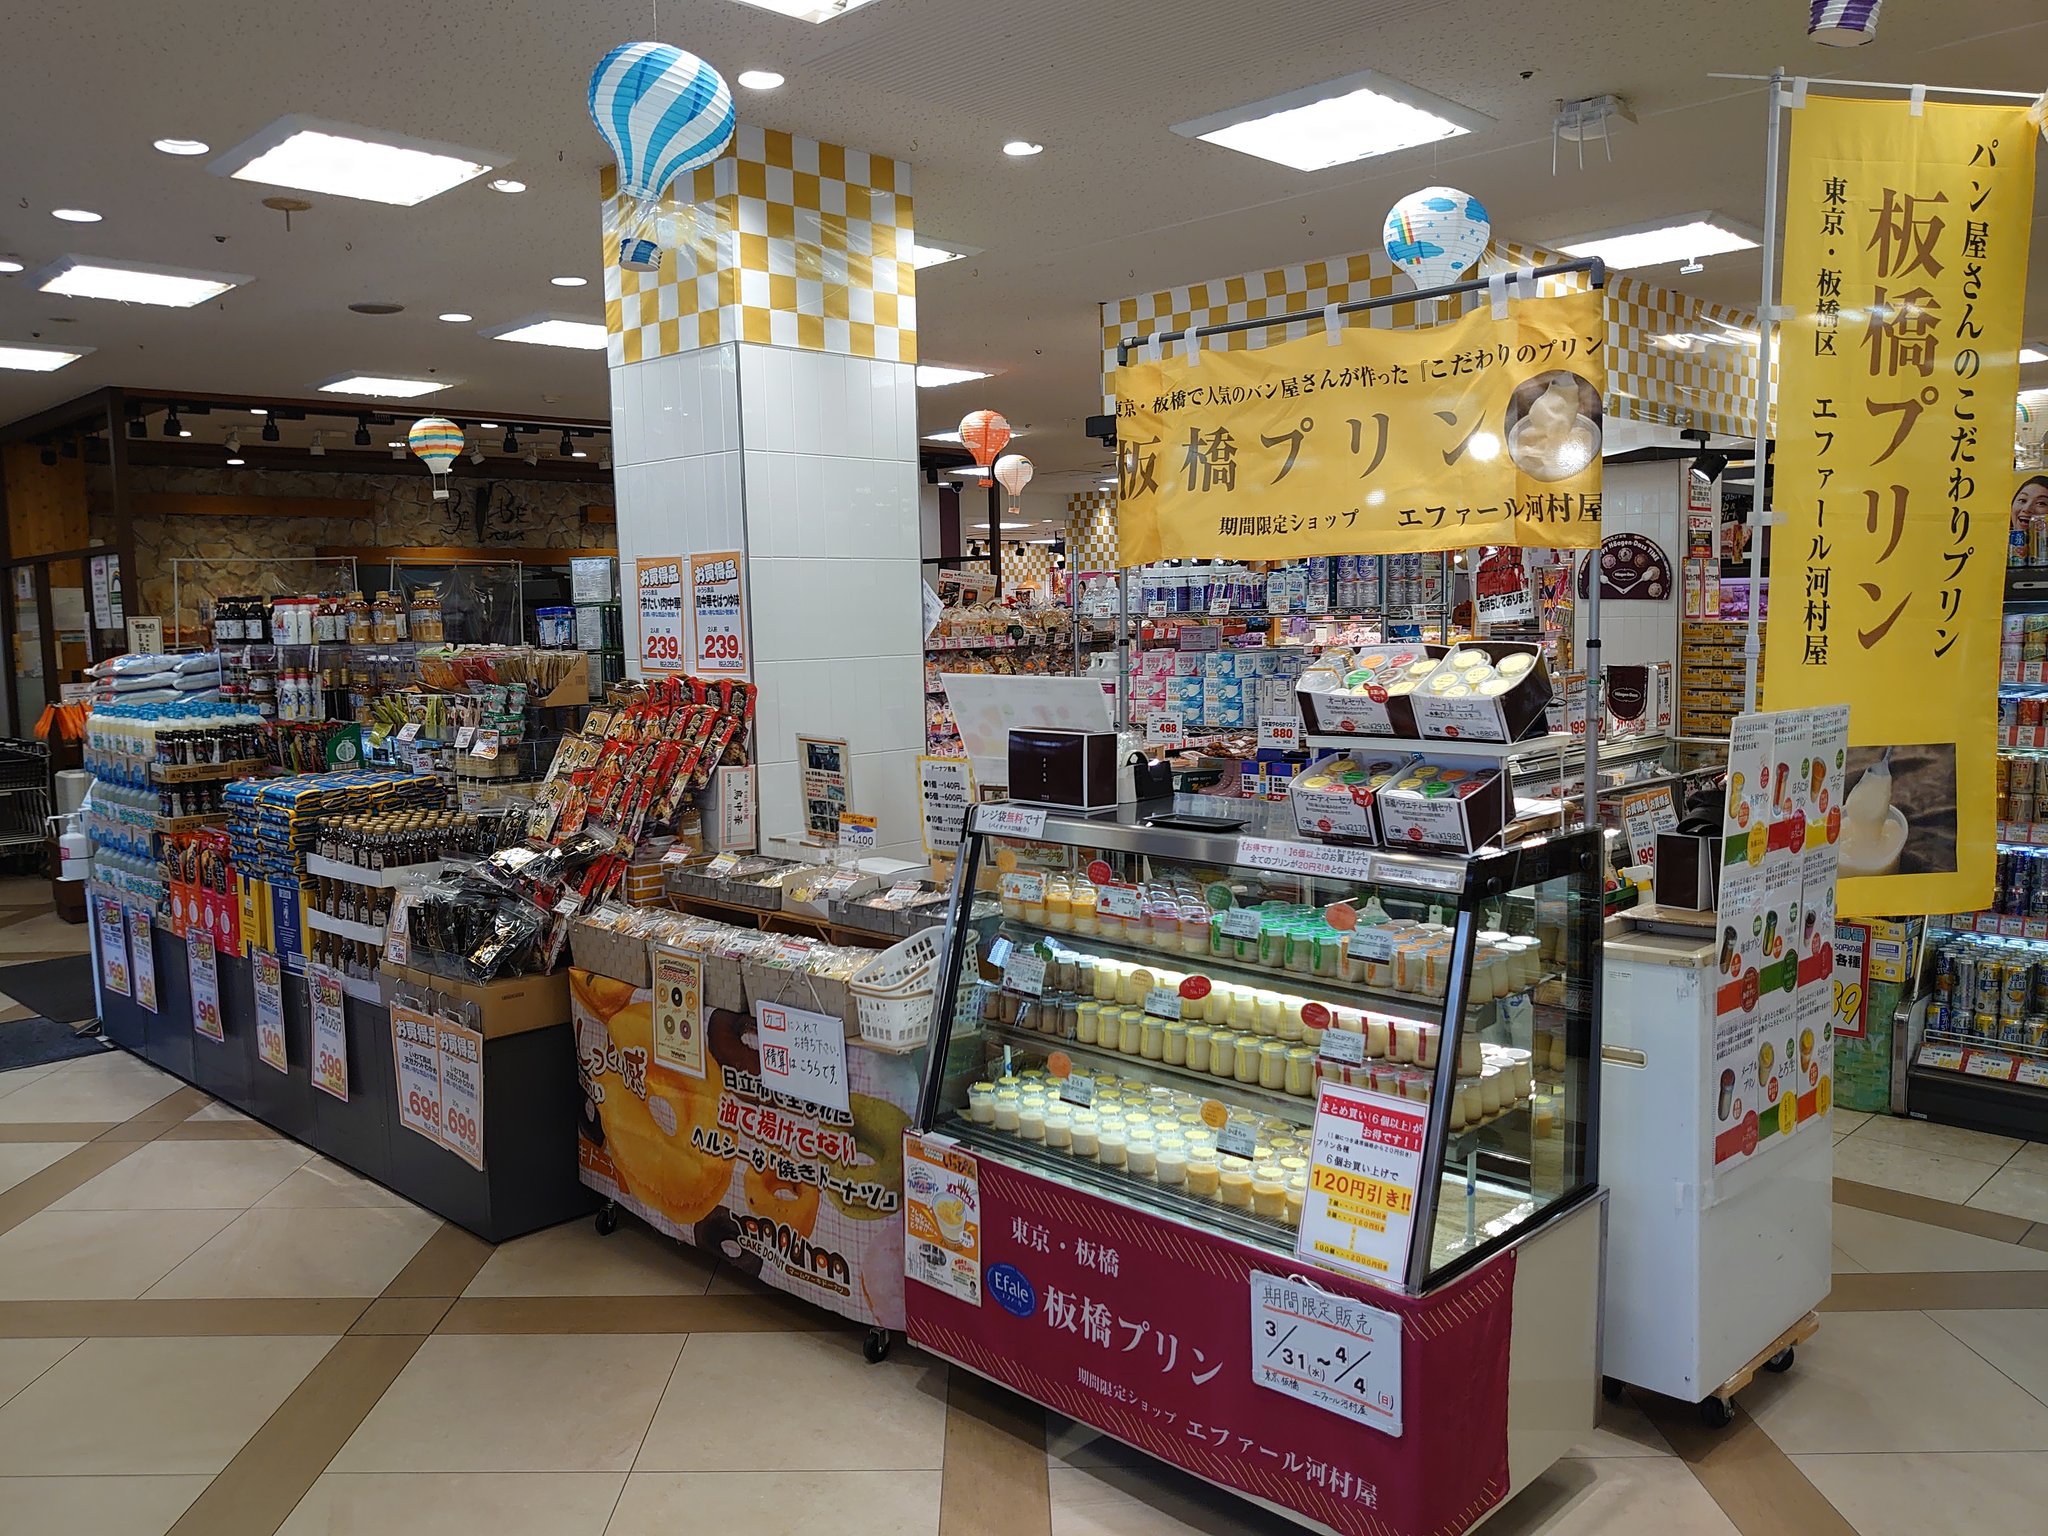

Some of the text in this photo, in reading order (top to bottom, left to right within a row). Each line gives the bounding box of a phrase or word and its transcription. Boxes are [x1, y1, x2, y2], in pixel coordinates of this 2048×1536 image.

[1934, 138, 1999, 658] パン屋さんのこだわりプリン
[1802, 176, 1848, 666] 東京・板橋区 エファール河村屋
[1857, 187, 1949, 650] 板橋プリン
[1117, 409, 1487, 500] 板橋プリン
[1218, 492, 1603, 537] 期間限定ショップ エファール河村屋
[640, 564, 680, 587] お買得品
[694, 559, 738, 585] お買得品
[640, 597, 681, 610] 冷たい肉中華
[647, 635, 678, 660] 239
[704, 634, 739, 659] 239
[1327, 696, 1366, 706] オールセット
[1159, 723, 1178, 733] 498
[1272, 728, 1293, 739] 880
[981, 809, 1043, 826] レジ袋無料です
[847, 834, 874, 846] ¥1,100
[1438, 832, 1462, 841] ¥1980
[1836, 953, 1861, 969] 各種
[262, 1027, 282, 1056] 149
[319, 1049, 343, 1082] 399
[409, 1090, 441, 1128] 699
[1321, 1101, 1423, 1133] まとめ買い(6個以上)が
[448, 1106, 477, 1147] 699
[719, 1097, 858, 1163] 油で揚げてない
[1316, 1138, 1351, 1154] プリン各種
[691, 1126, 898, 1210] ヘルシーな「焼きドーナツ」
[1326, 1153, 1400, 1181] 6個お買い上げで
[1313, 1169, 1412, 1211] 120円引き!!
[739, 1236, 786, 1272] CAKE DONUT
[1010, 1215, 1120, 1279] 東京・板橋
[994, 1271, 1029, 1303] Efale
[1263, 1285, 1373, 1337] 期間限定販売
[1042, 1284, 1224, 1387] 板橋プリン
[1077, 1366, 1380, 1512] 期間限定ショップ エファール河村屋
